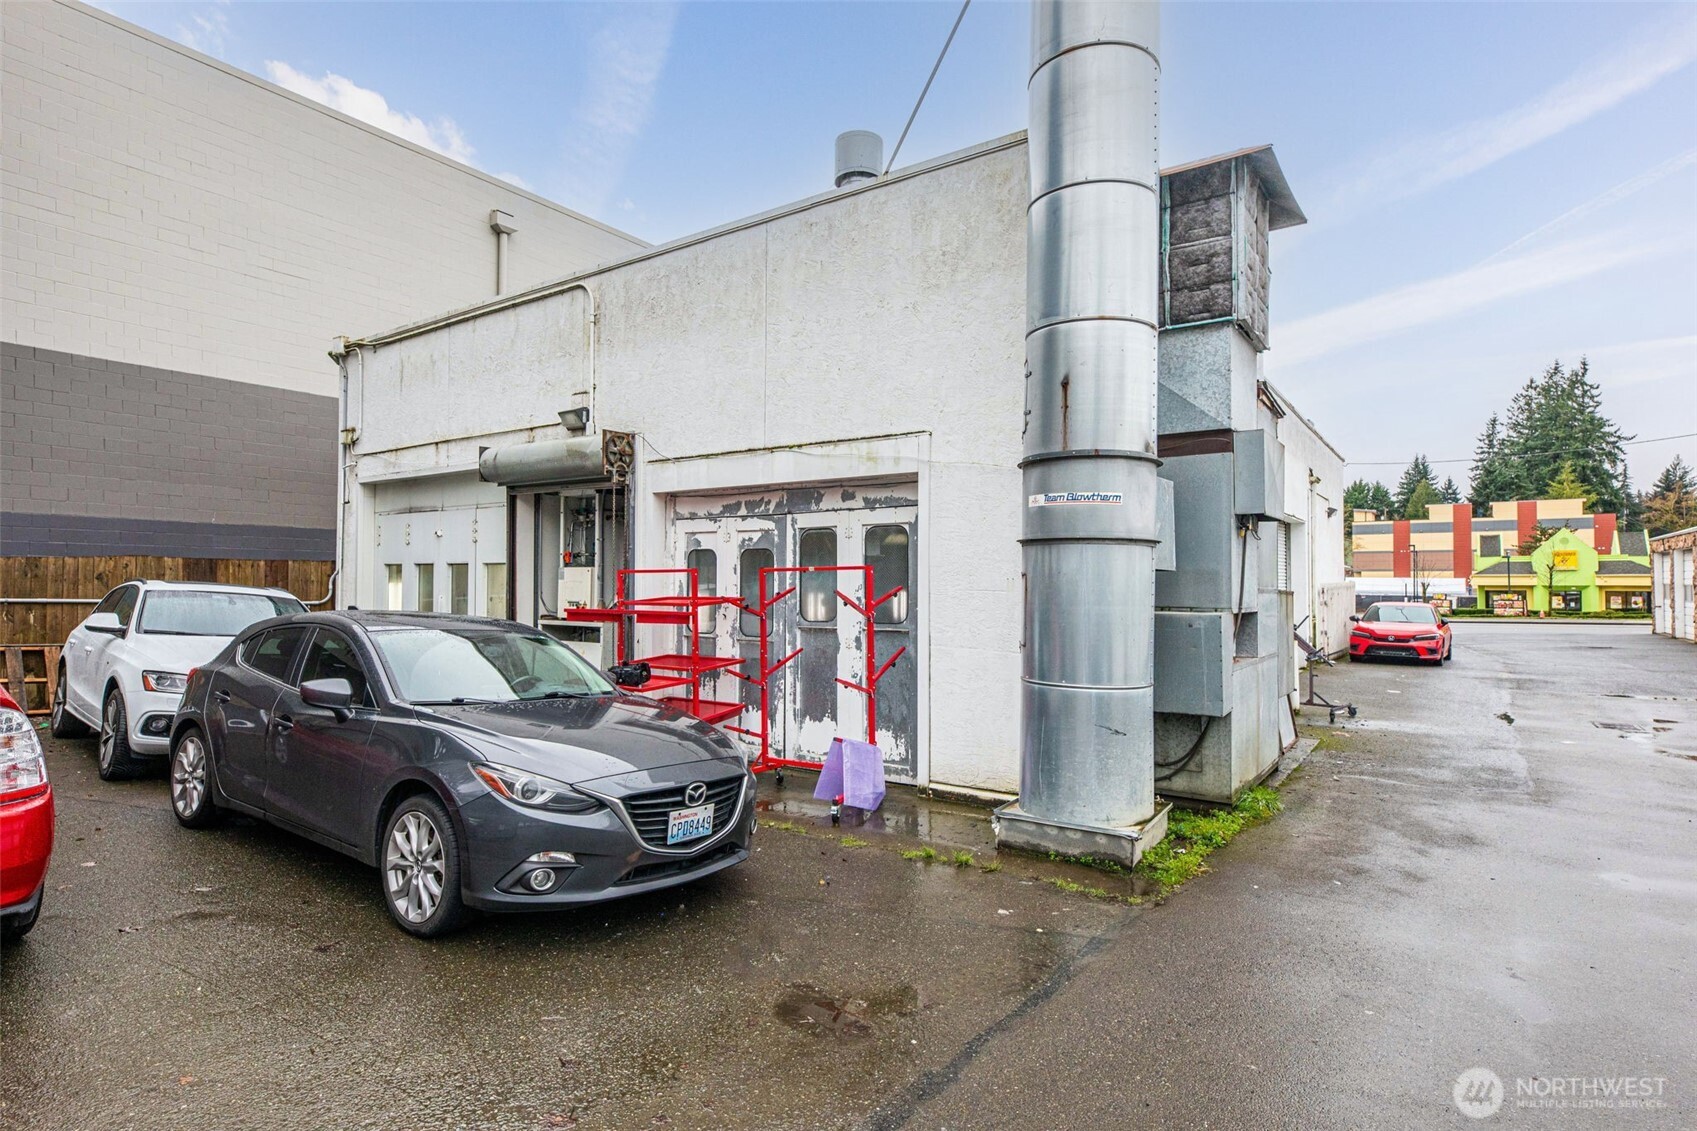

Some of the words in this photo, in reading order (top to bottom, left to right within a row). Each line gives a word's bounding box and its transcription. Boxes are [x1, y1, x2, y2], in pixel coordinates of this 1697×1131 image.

[1043, 493, 1065, 502] Team
[1066, 492, 1122, 502] Blowtherm
[670, 815, 712, 840] CPD8449
